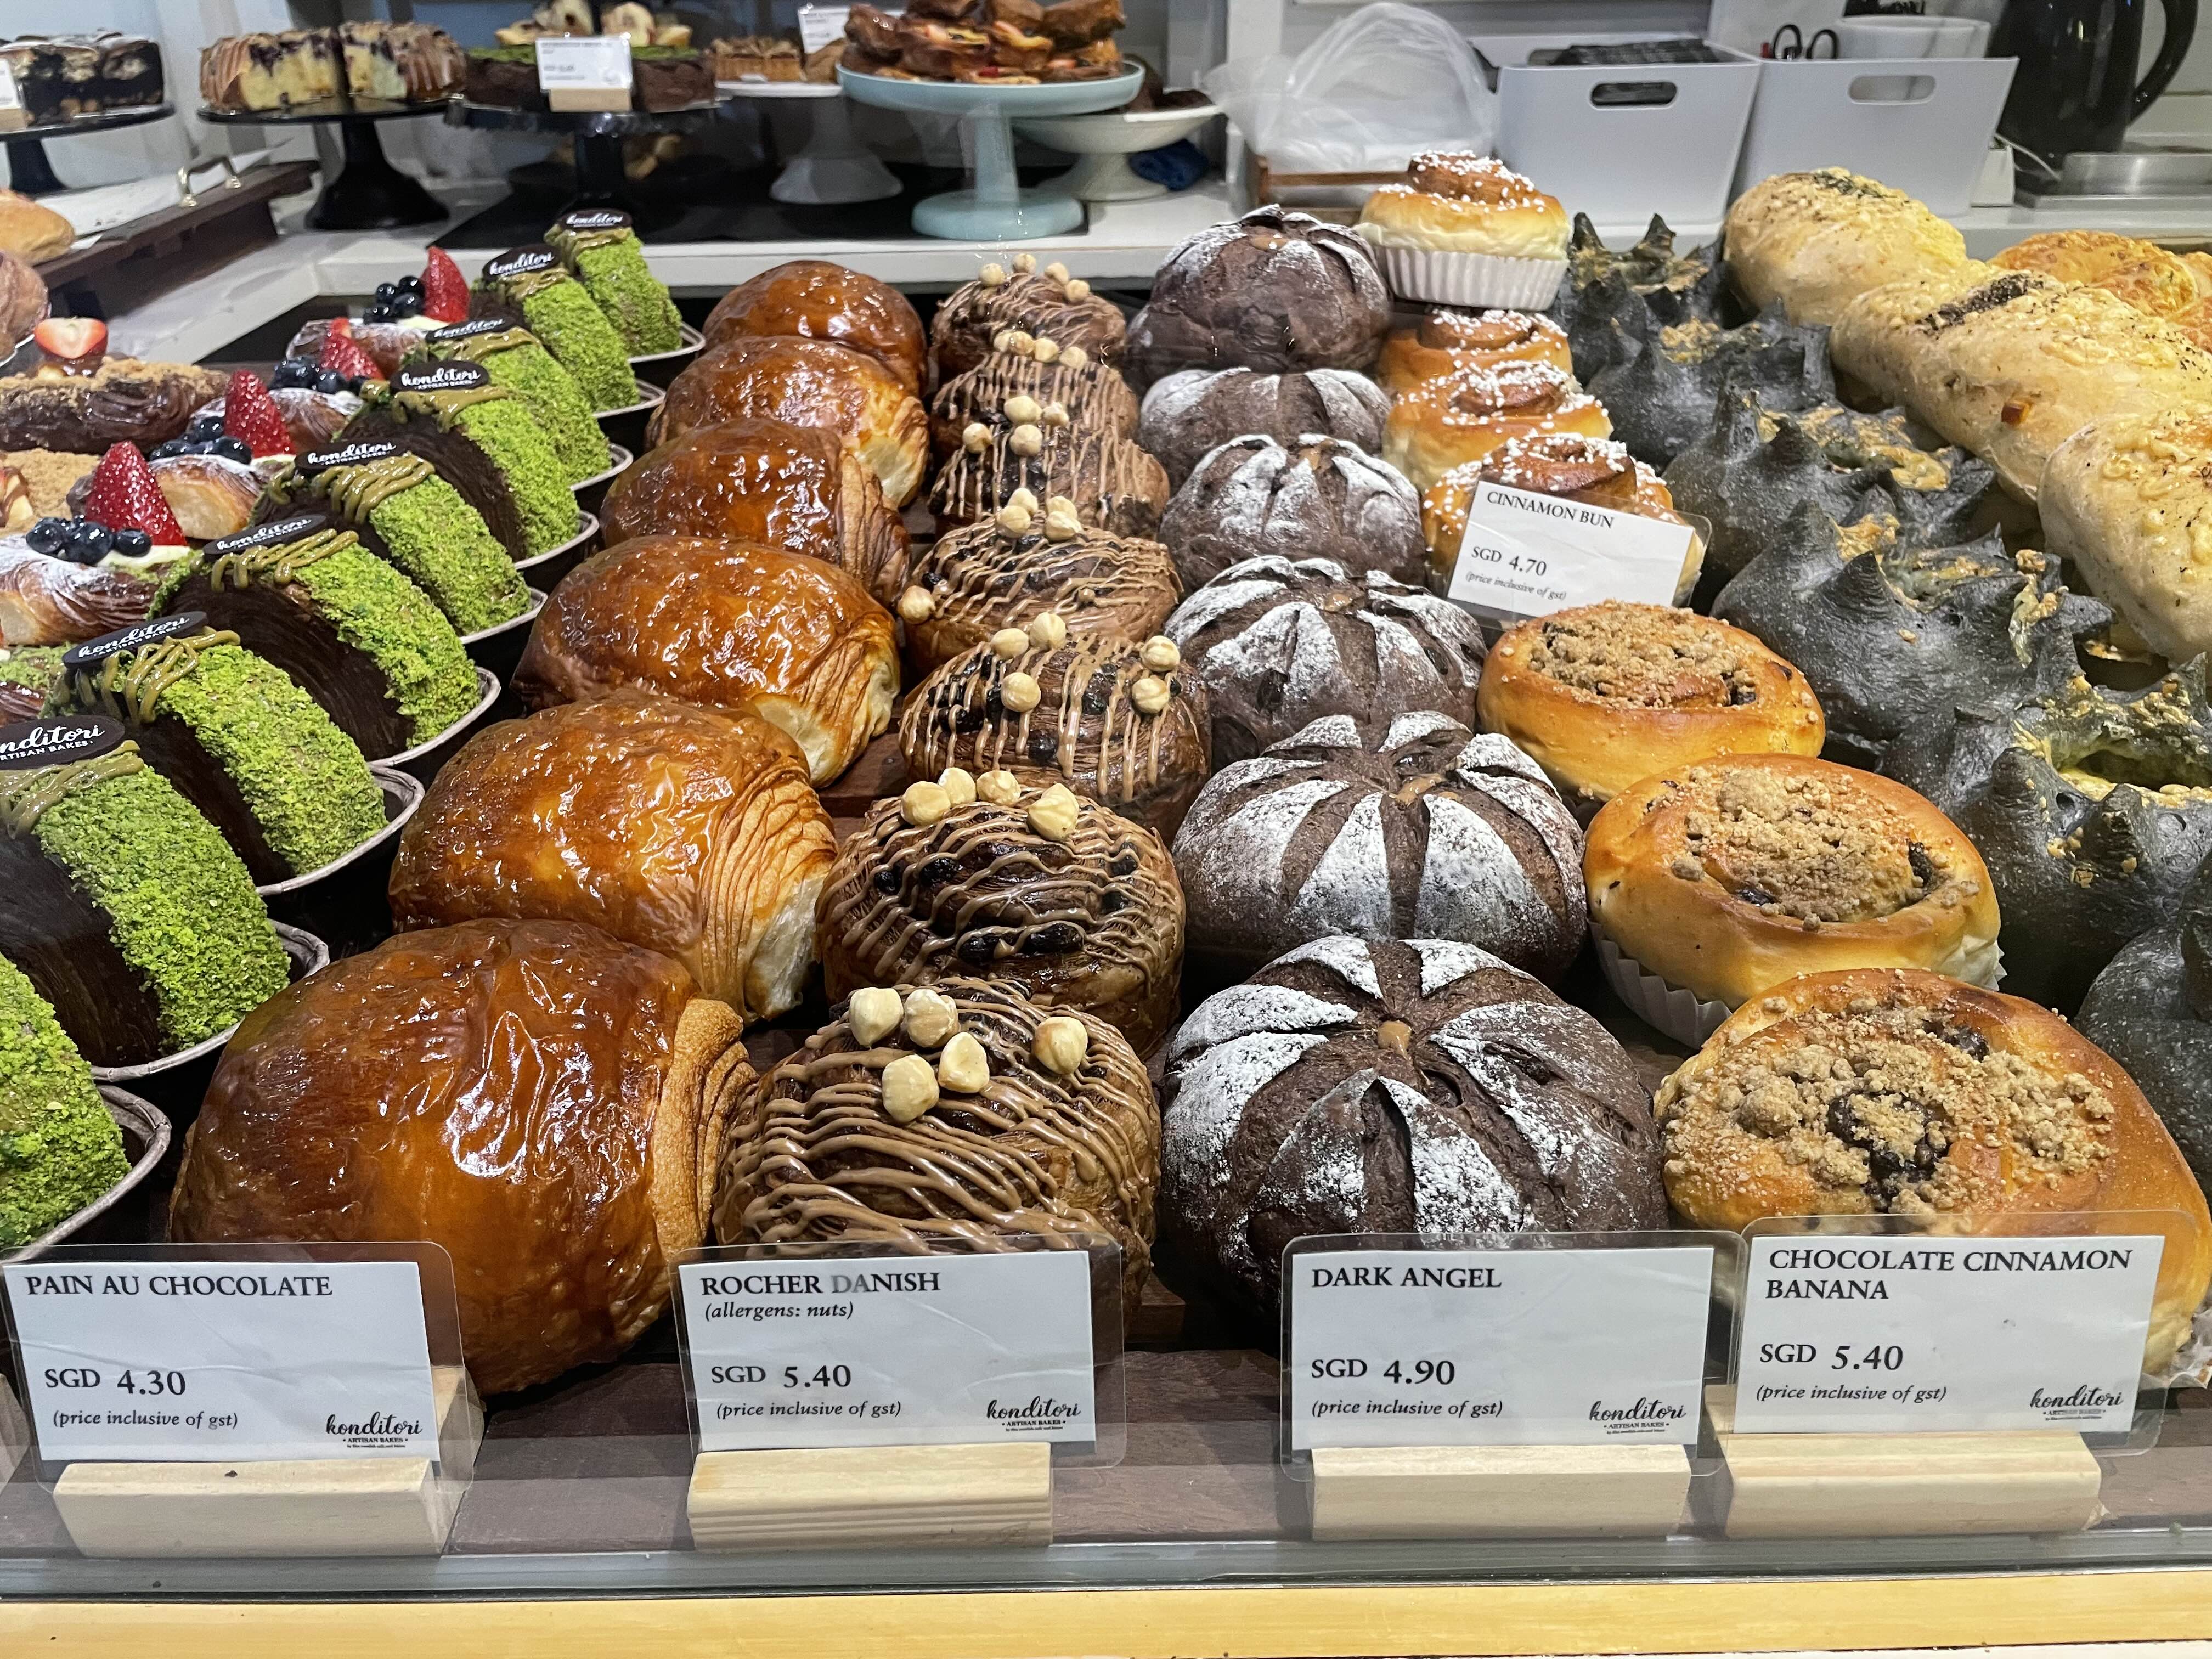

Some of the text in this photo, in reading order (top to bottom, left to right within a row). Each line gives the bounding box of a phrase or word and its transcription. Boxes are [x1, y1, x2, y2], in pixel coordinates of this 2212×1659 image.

[401, 367, 481, 386] konditori
[307, 442, 396, 464] konditori
[1487, 491, 1615, 528] CINNAMON BUN
[1471, 546, 1547, 576] SGD 4.70
[1465, 571, 1492, 583] (price
[1494, 577, 1534, 593] inclusive
[78, 617, 190, 657] konditori
[0, 725, 105, 753] nditori
[0, 740, 88, 761] RTISAN BAKES
[1770, 1250, 2133, 1271] CHOCOLATE CINNAMON
[25, 1276, 332, 1296] PAIN AU CHOCOLATE
[700, 1273, 940, 1295] ROCHER DANISH
[1312, 1267, 1502, 1288] DARK ANGEL
[1765, 1280, 1888, 1299] BANANA
[706, 1302, 853, 1321] (allergens: nuts)
[1760, 1344, 1903, 1370] SGD 5.40
[45, 1369, 185, 1395] SGD 4.30
[712, 1365, 851, 1387] SGD 5.40
[1312, 1359, 1454, 1385] SGD 4.90
[1757, 1385, 1946, 1403] (price inclusive of gst)
[2030, 1385, 2124, 1408] konditori
[717, 1401, 900, 1419] (price inclusive of gst)
[986, 1396, 1081, 1419] konditori
[1312, 1400, 1502, 1418] (price inclusive of gst)
[1589, 1397, 1686, 1421] konditori
[54, 1410, 237, 1429] (price inclusive of gst)
[326, 1411, 423, 1435] konditori
